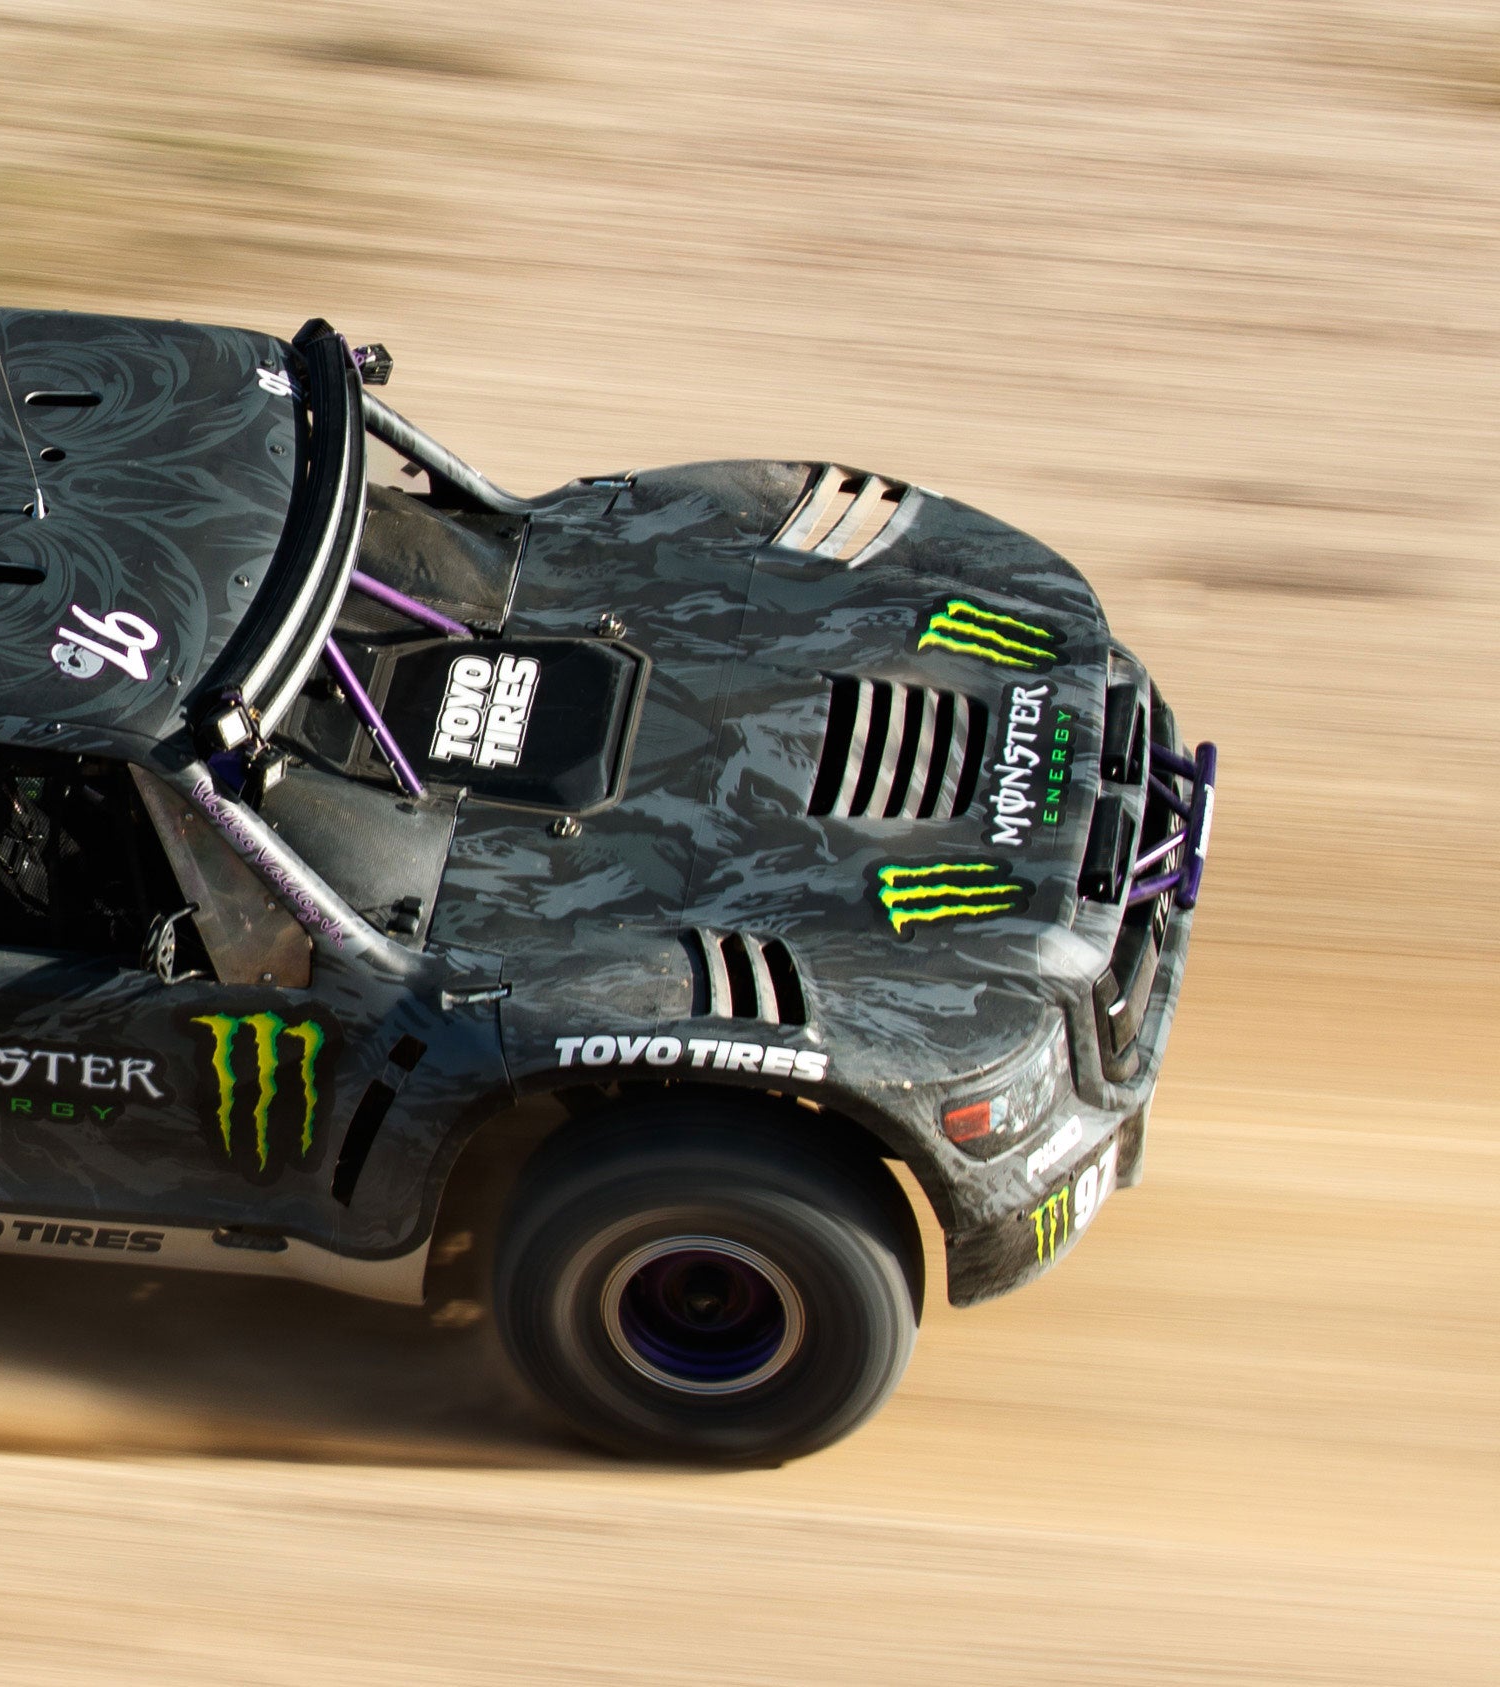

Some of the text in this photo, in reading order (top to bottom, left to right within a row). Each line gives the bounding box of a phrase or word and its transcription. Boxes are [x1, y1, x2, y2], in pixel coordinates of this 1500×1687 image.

[58, 604, 159, 680] 91
[429, 655, 496, 762] TOYO
[473, 652, 541, 769] TIRES
[990, 685, 1049, 845] MONSTER
[1043, 710, 1072, 824] ENERGY
[554, 1035, 829, 1082] TOYO TIRES
[1074, 1141, 1118, 1230] 91
[12, 1220, 165, 1253] TIRES
